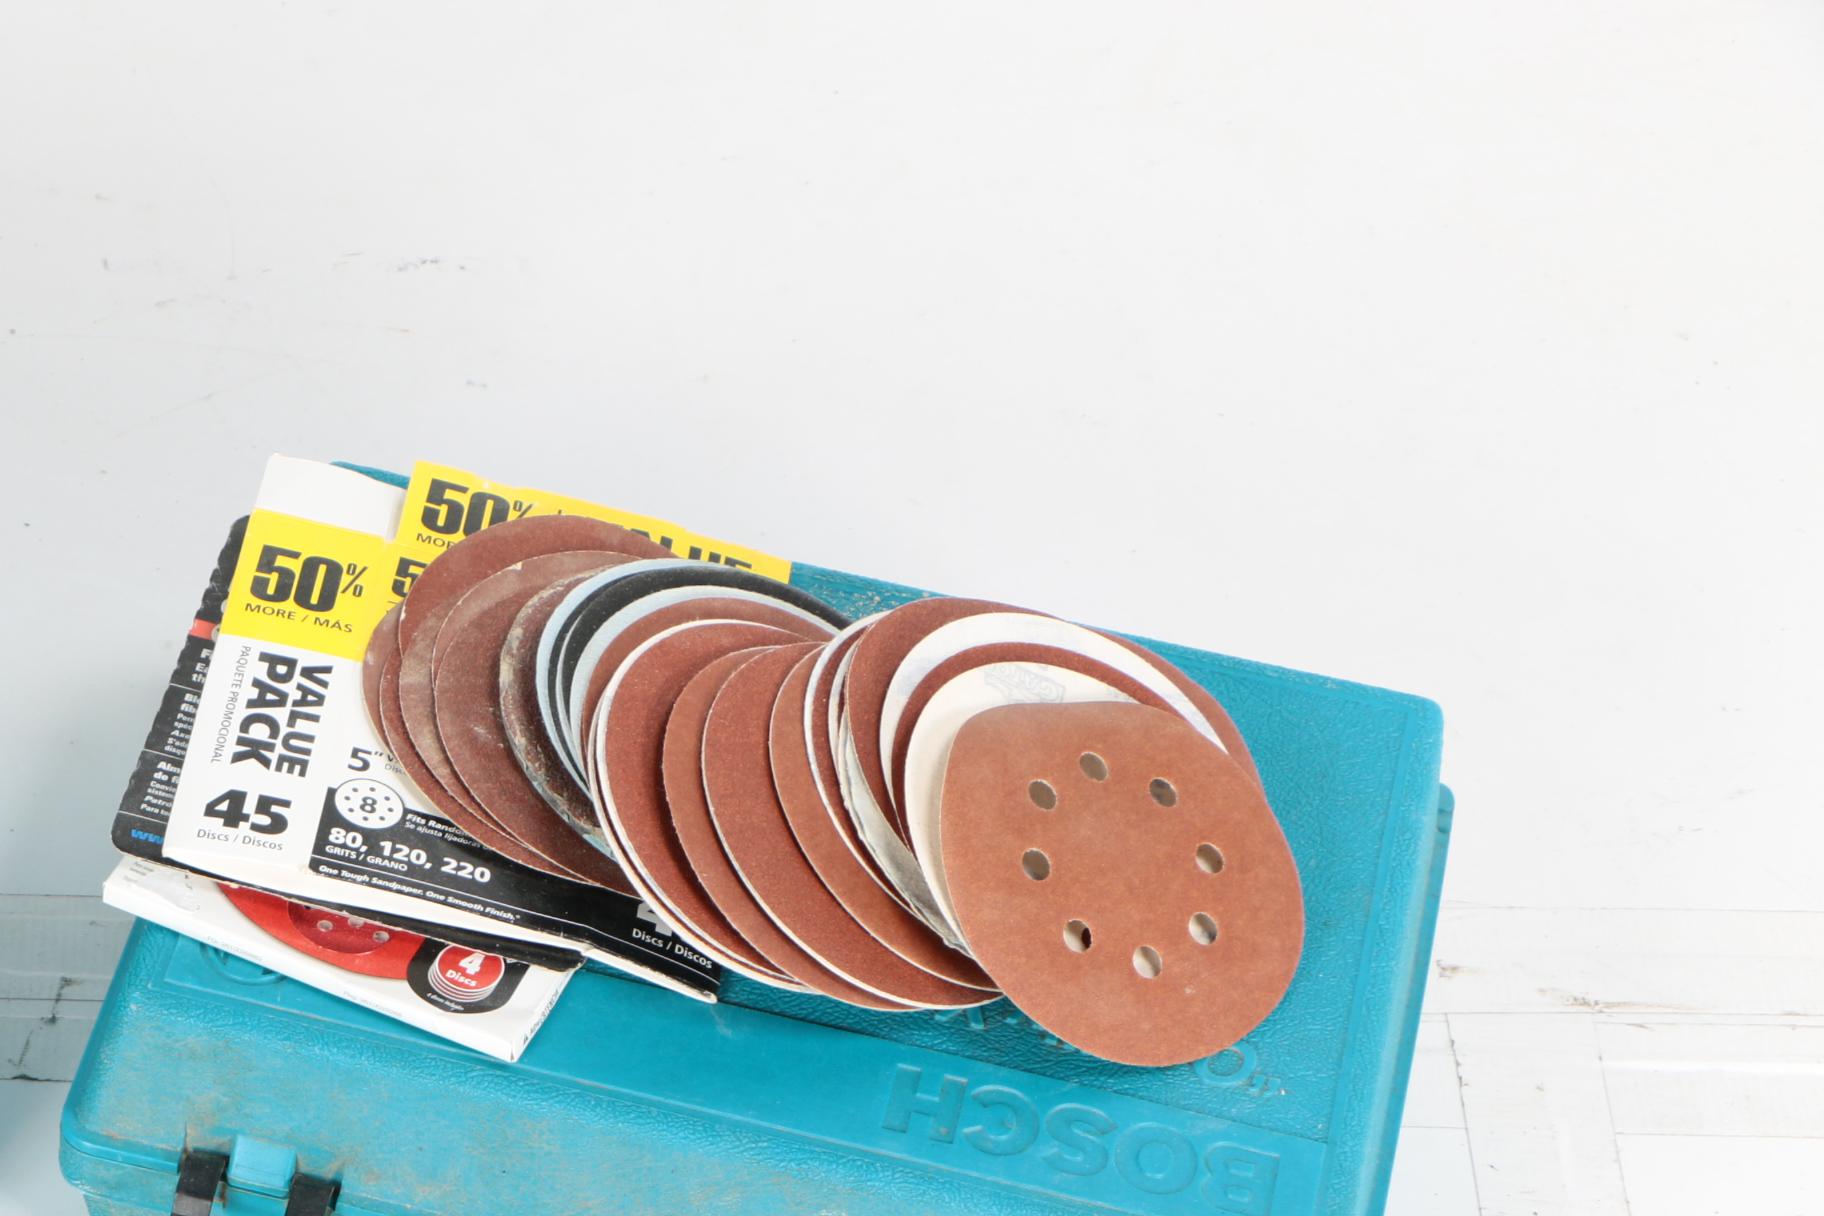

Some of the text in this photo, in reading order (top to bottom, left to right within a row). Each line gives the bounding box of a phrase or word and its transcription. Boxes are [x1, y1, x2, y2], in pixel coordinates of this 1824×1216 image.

[250, 544, 369, 613] 50%
[245, 603, 353, 633] MORE / MÁS
[210, 645, 252, 763] PAQUETE PROMOCIONAL
[230, 651, 298, 771] PACK
[275, 665, 333, 778] VALUE
[203, 789, 292, 835] 45
[359, 796, 378, 814] 8
[405, 814, 426, 825] Fits
[197, 828, 284, 851] Discs / Discos
[404, 821, 415, 830] Se
[419, 825, 443, 839] ajusta
[325, 845, 357, 860] GRITS
[367, 855, 408, 872] GRANO
[328, 827, 492, 884] 80, 120, 220
[318, 865, 338, 876] One
[341, 869, 370, 884] Tough
[426, 890, 445, 901] One
[447, 896, 484, 912] Smooth
[458, 952, 486, 975] 4
[632, 928, 713, 969] Discs / Discos
[446, 969, 477, 987] Discs
